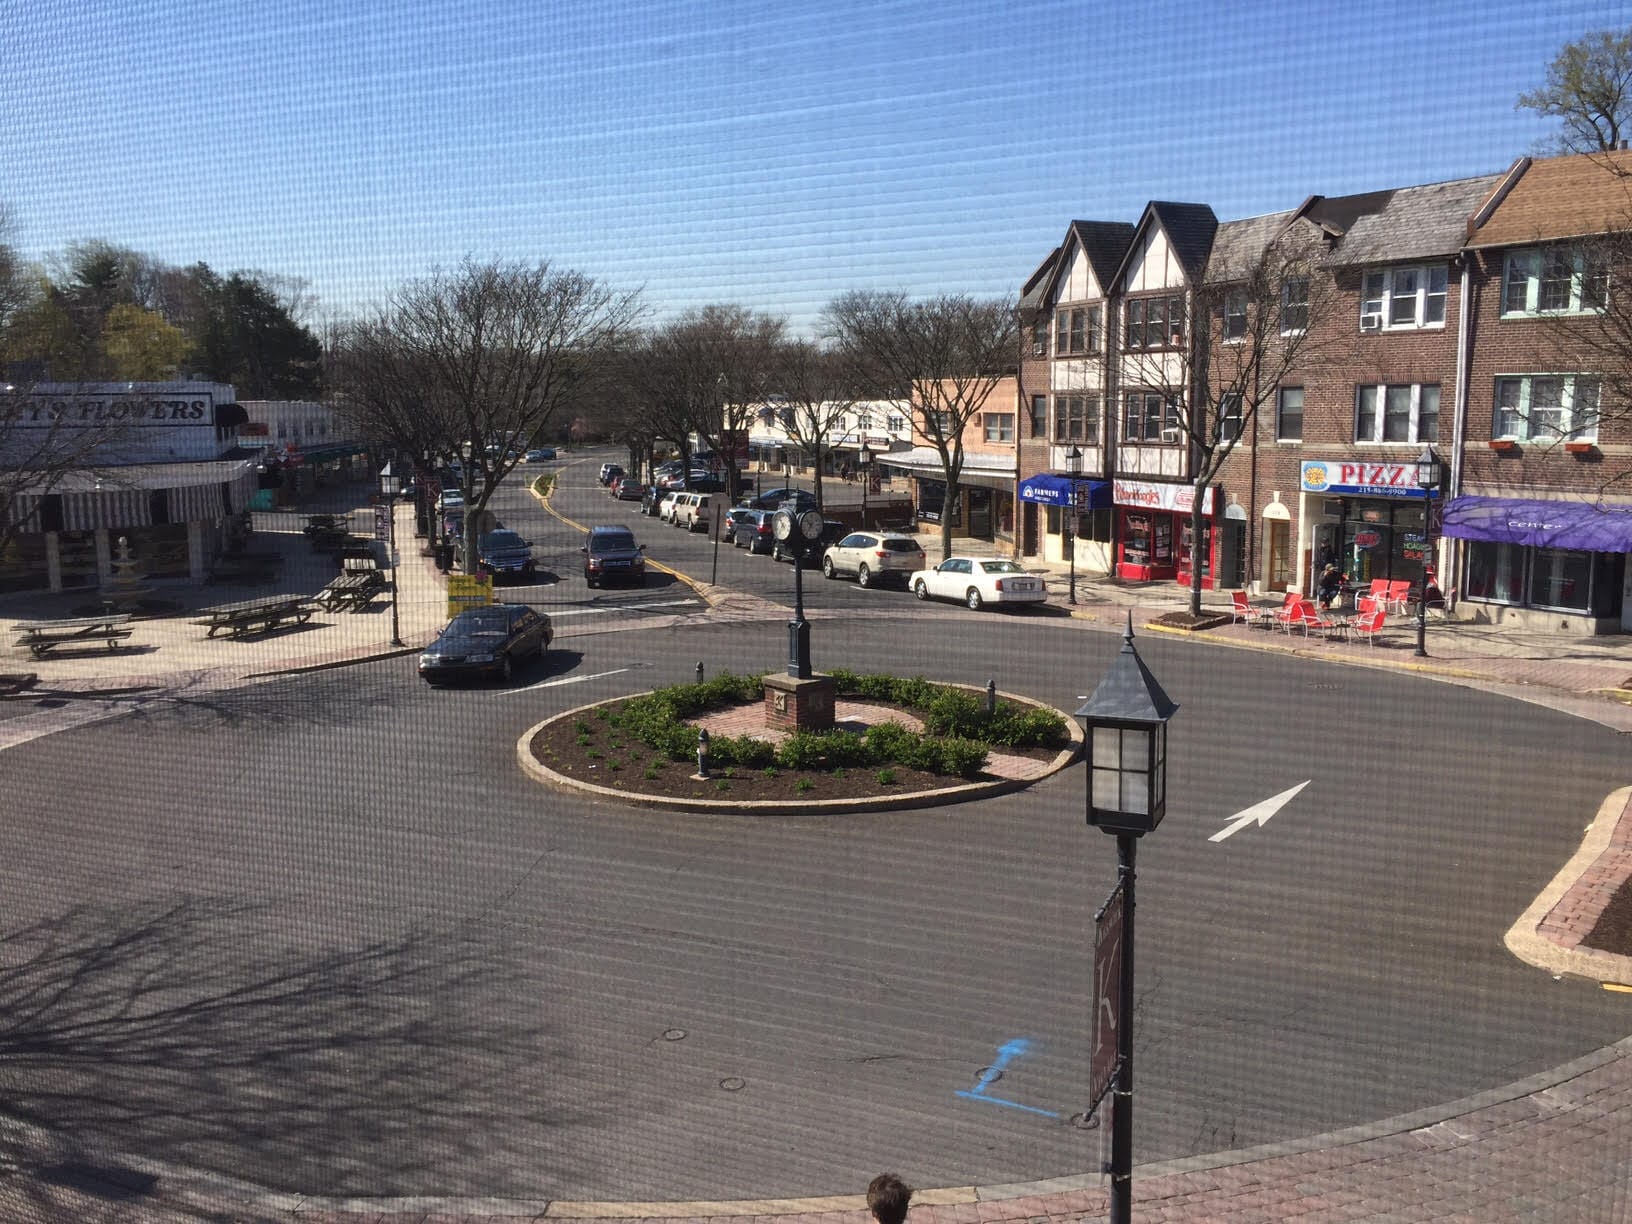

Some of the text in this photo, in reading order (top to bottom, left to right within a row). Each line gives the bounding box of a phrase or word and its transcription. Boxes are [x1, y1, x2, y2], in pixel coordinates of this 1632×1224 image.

[79, 399, 205, 421] FLOWERS
[871, 477, 880, 490] K
[1034, 488, 1059, 499] FARMERS
[1432, 508, 1442, 529] K
[1094, 936, 1119, 1058] K
